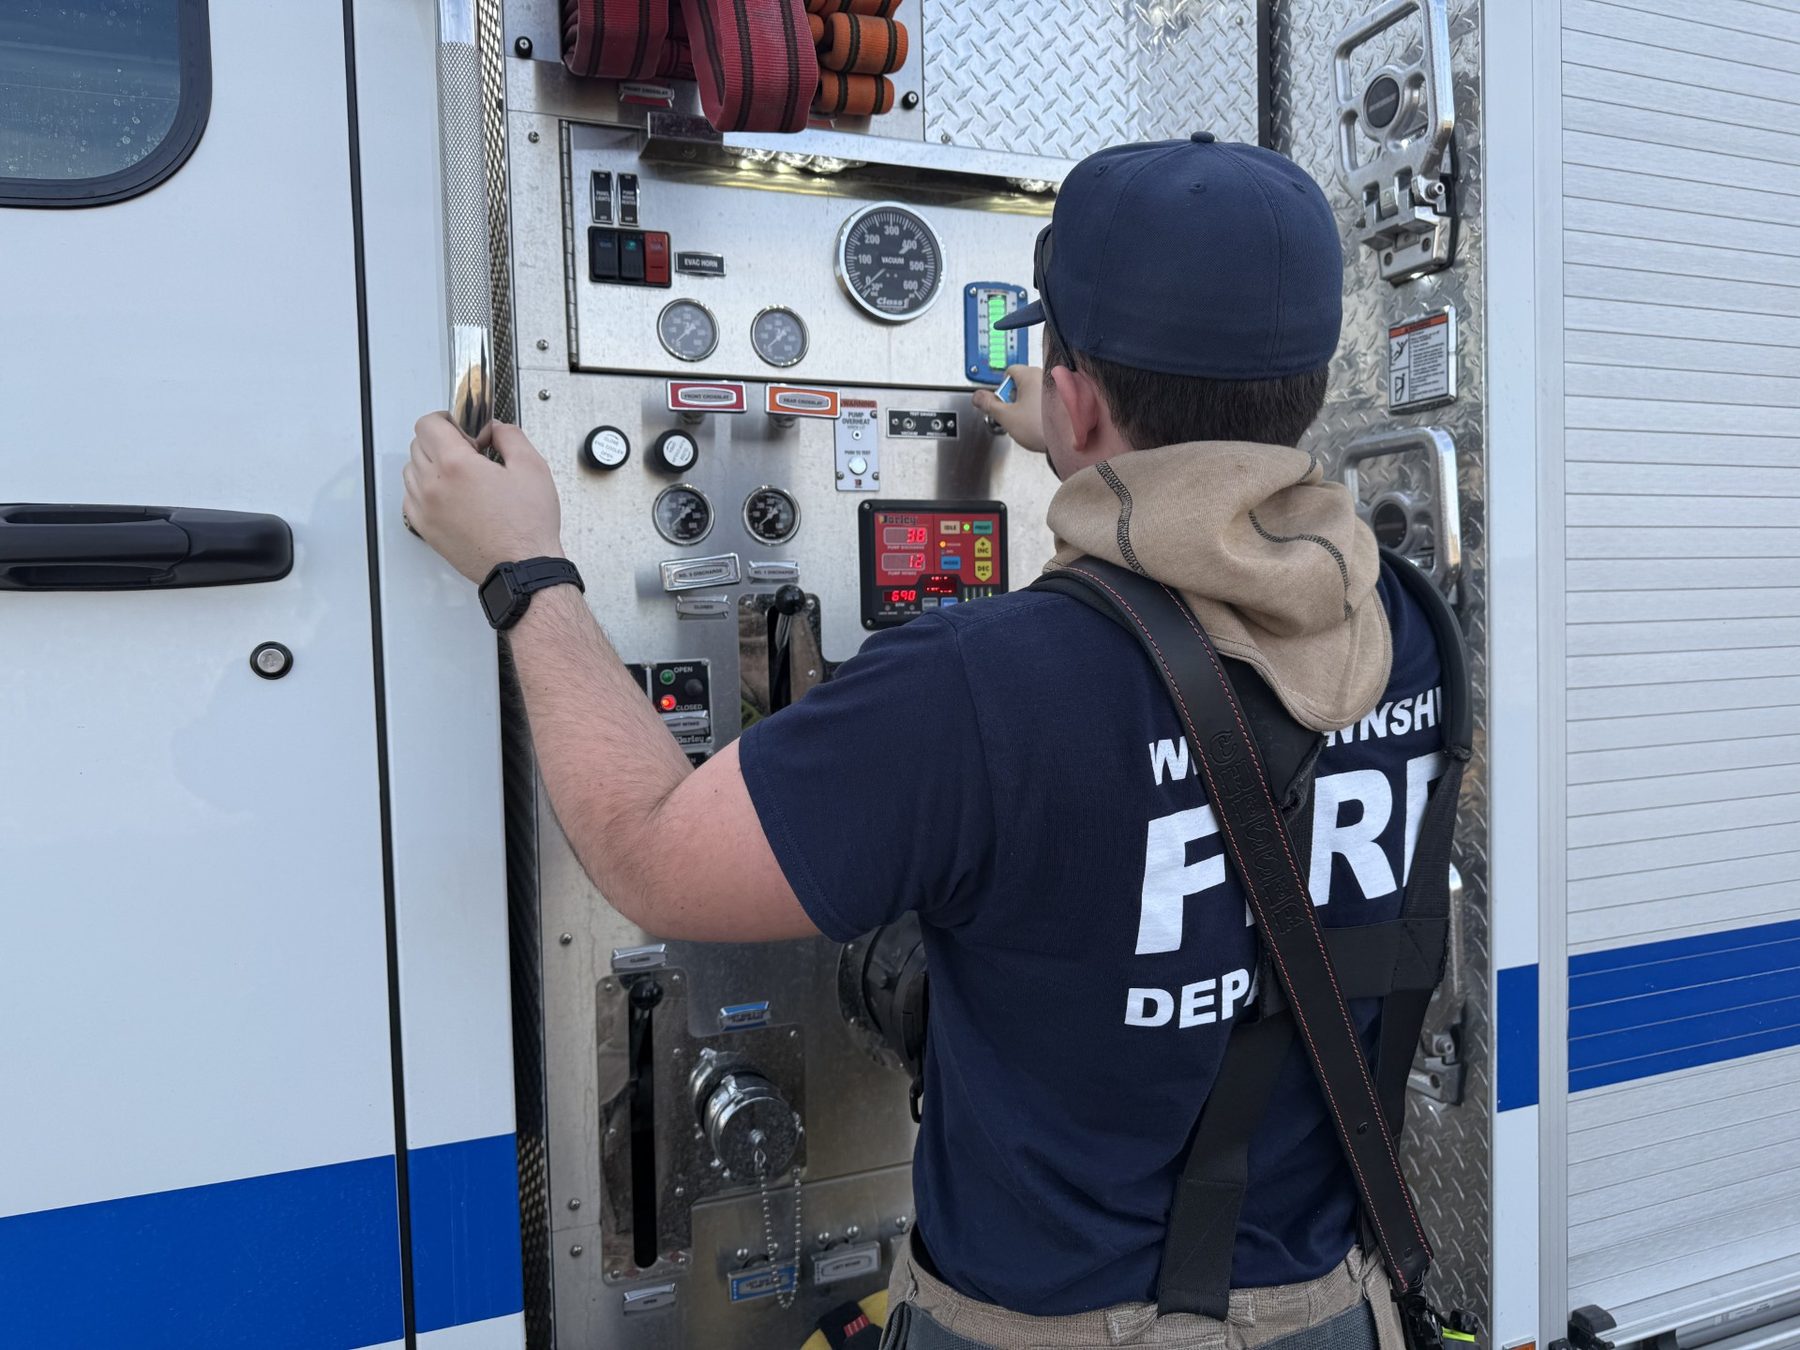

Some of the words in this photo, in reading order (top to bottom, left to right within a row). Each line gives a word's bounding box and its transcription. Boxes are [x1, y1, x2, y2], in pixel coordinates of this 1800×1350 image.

[884, 225, 900, 235] 300
[864, 234, 880, 245] 200
[901, 239, 917, 250] 400
[684, 258, 700, 266] EVAC
[701, 259, 718, 268] HORN
[858, 254, 872, 264] 100
[881, 256, 905, 264] VACUUM
[909, 261, 924, 271] 500
[903, 280, 918, 290] 600
[843, 400, 876, 408] WARNING
[907, 527, 926, 544] 38
[909, 553, 924, 568] 12
[891, 590, 916, 602] 690
[676, 703, 703, 711] CLOSED
